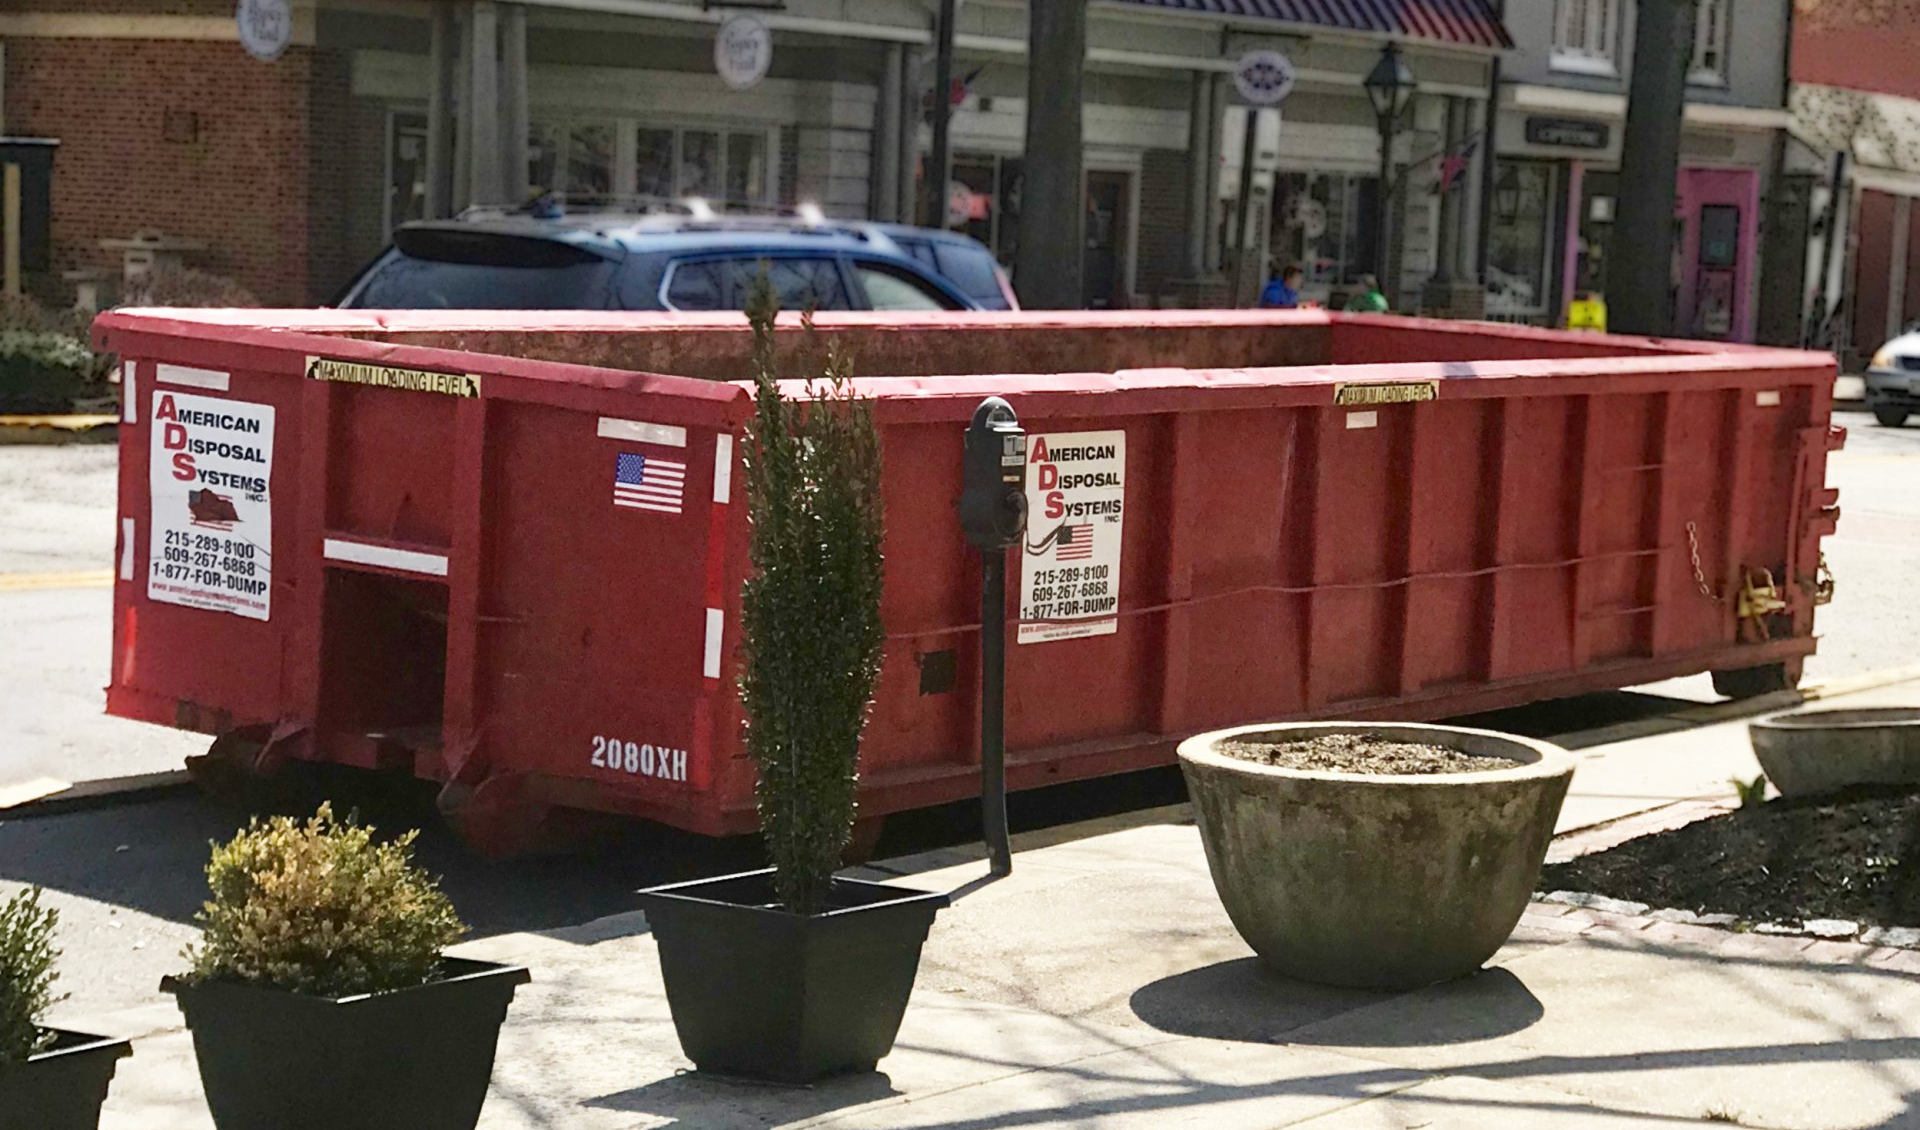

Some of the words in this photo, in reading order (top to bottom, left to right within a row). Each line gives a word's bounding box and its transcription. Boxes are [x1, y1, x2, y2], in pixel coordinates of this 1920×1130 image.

[319, 361, 372, 384] MAXIMUM
[375, 369, 426, 391] LOADING
[430, 375, 465, 396] LEVEL
[156, 395, 260, 433] AMERICAN
[164, 422, 266, 463] DISPOSAL
[1030, 436, 1115, 464] AMERICAN
[172, 453, 266, 493] SYSTEMS
[1039, 464, 1120, 491] DISPOSAL
[245, 493, 267, 503] INC.
[1045, 491, 1121, 519] SYSTEMS
[165, 529, 255, 559] 215-289-8100
[164, 546, 255, 576] 609-267-6868
[1034, 564, 1108, 586] 215-289-8100
[153, 562, 267, 596] 1-877-FOR-DUMP
[1032, 581, 1108, 602] 609-267-6868
[1022, 597, 1116, 620] 1-877-FOR-DUMP
[591, 735, 687, 782] 2080XH
